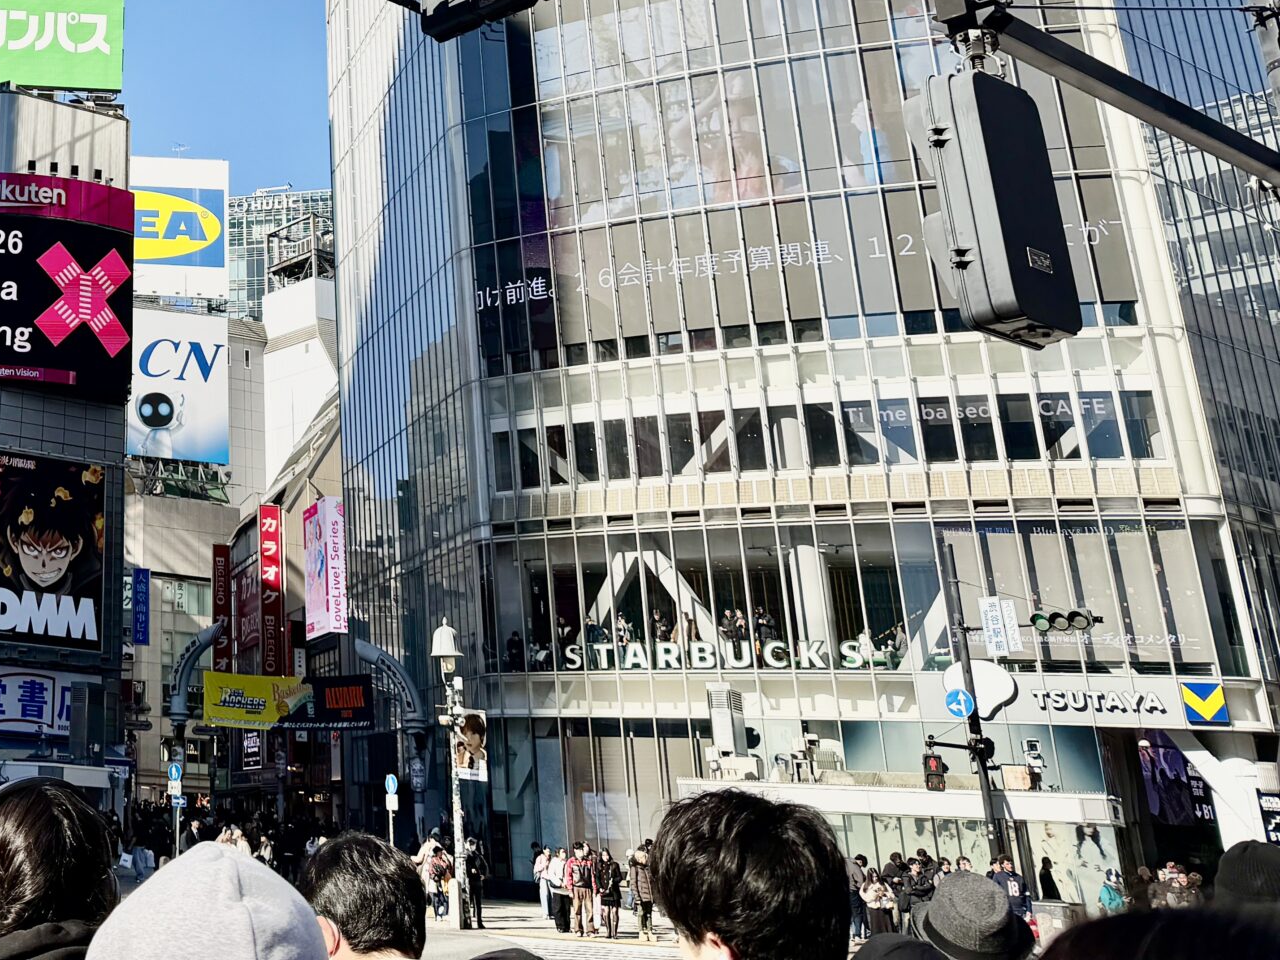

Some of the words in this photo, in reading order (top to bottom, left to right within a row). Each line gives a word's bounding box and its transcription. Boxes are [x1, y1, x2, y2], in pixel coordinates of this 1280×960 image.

[13, 367, 40, 379] Vision
[921, 401, 993, 422] based
[1037, 397, 1107, 418] CAFE
[330, 520, 340, 560] Series
[262, 517, 279, 604] カラオケ
[564, 638, 868, 670] STARBUCKS
[218, 687, 267, 710] ROCKERS
[325, 685, 366, 709] ALVARK
[1031, 689, 1168, 715] TSUTAYA
[1202, 804, 1214, 820] B1
[1007, 880, 1020, 898] 18
